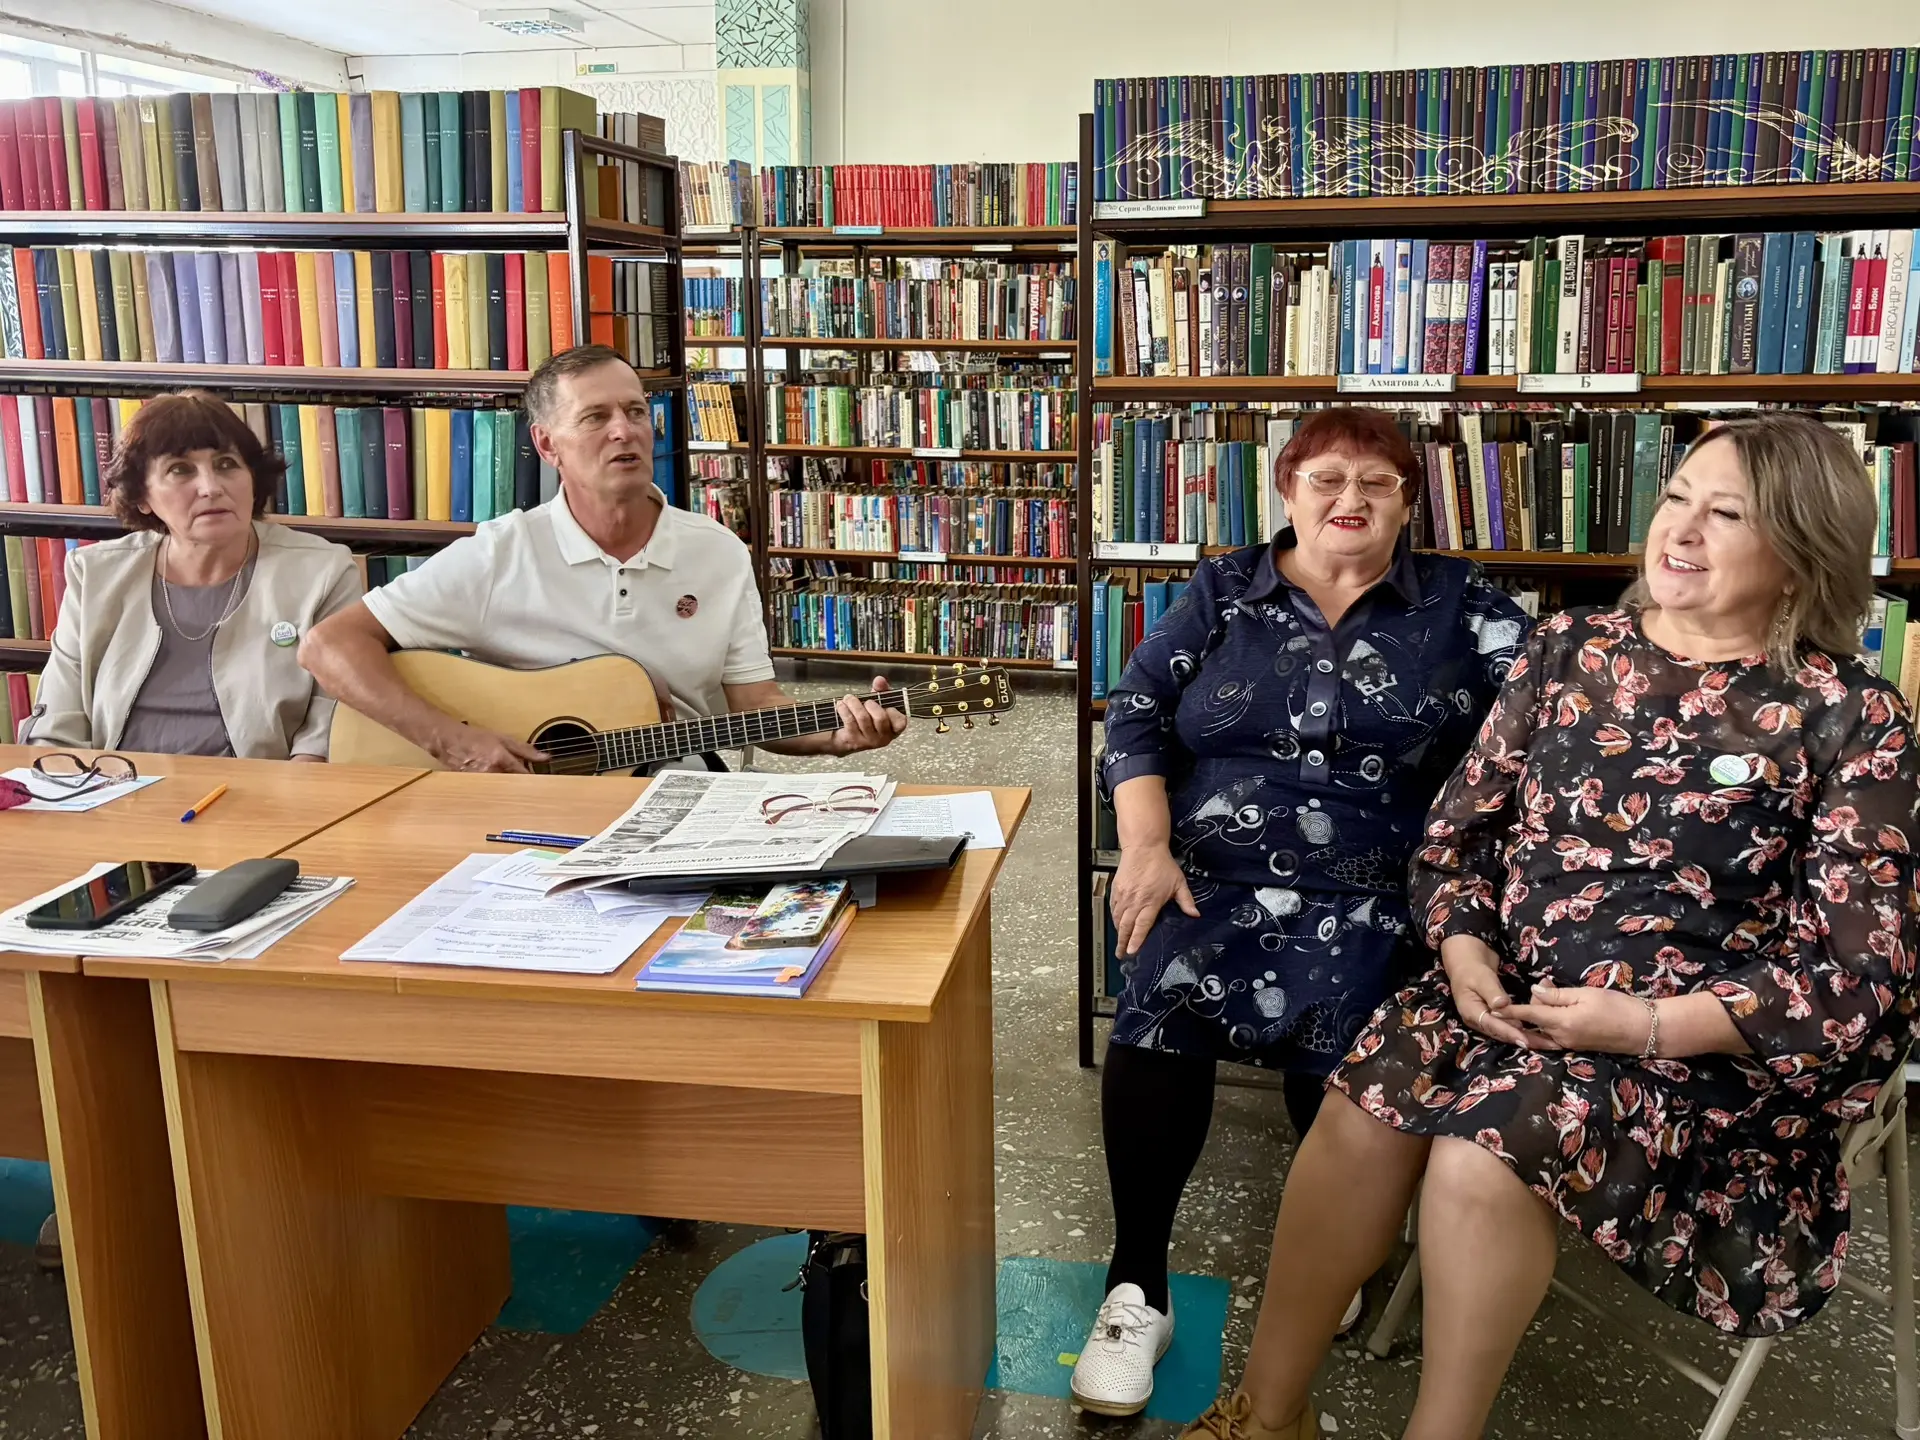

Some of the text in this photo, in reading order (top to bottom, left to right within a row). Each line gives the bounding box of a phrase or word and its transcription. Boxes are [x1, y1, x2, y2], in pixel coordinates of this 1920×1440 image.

[1118, 205, 1140, 213] Серия
[1565, 240, 1578, 281] БАЛЬМОНТ
[1031, 284, 1039, 331] БЛОКАДА
[1372, 285, 1381, 326] Ахматова
[1469, 282, 1480, 320] АХМАТОВА
[1852, 287, 1863, 310] Блок
[1868, 287, 1879, 310] Блок
[1884, 252, 1904, 352] АЛЕКСАНДР БЛОК
[1742, 303, 1755, 360] БЕРГГОЛЬЦ
[1466, 329, 1475, 369] РАНЕВСКАЯ
[1368, 377, 1445, 387] Ахматова А.А.
[1580, 376, 1591, 388] Б
[1149, 545, 1159, 556] В
[997, 675, 1009, 704] JOYO
